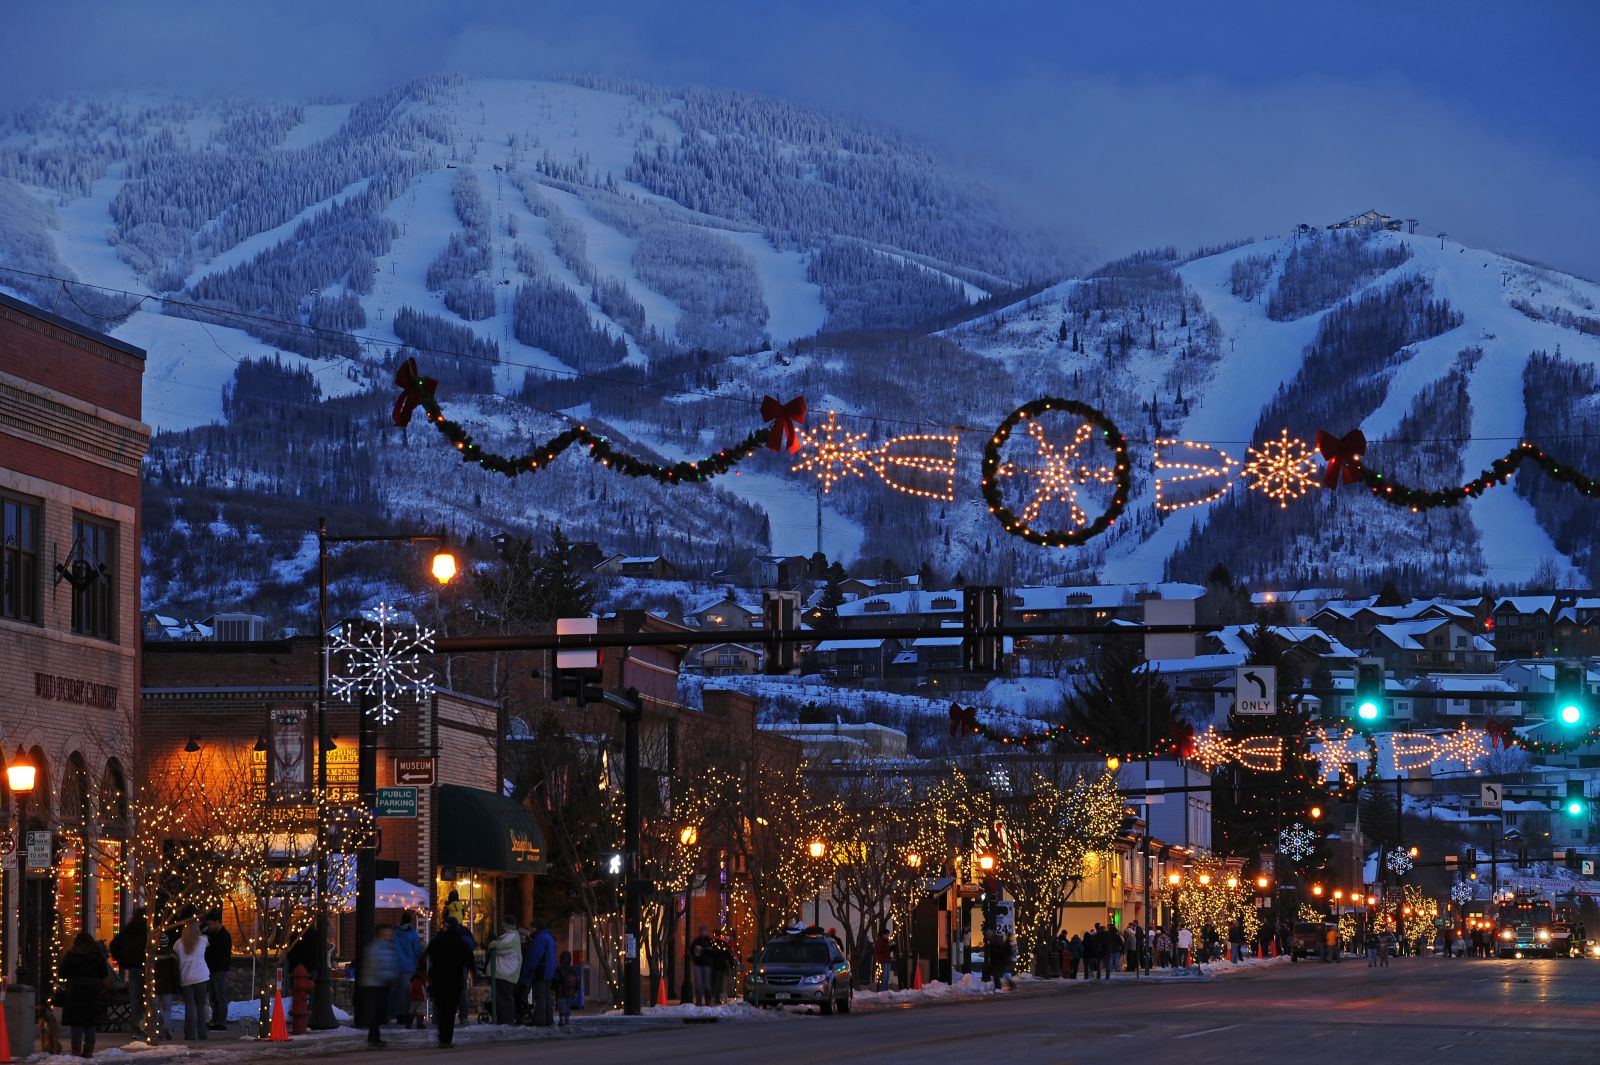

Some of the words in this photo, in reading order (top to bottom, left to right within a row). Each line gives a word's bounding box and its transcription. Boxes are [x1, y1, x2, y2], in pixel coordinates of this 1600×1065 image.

[1241, 701, 1270, 710] ONLY
[400, 761, 431, 770] MUSEUM
[379, 799, 415, 807] PARKING
[28, 834, 34, 844] 2
